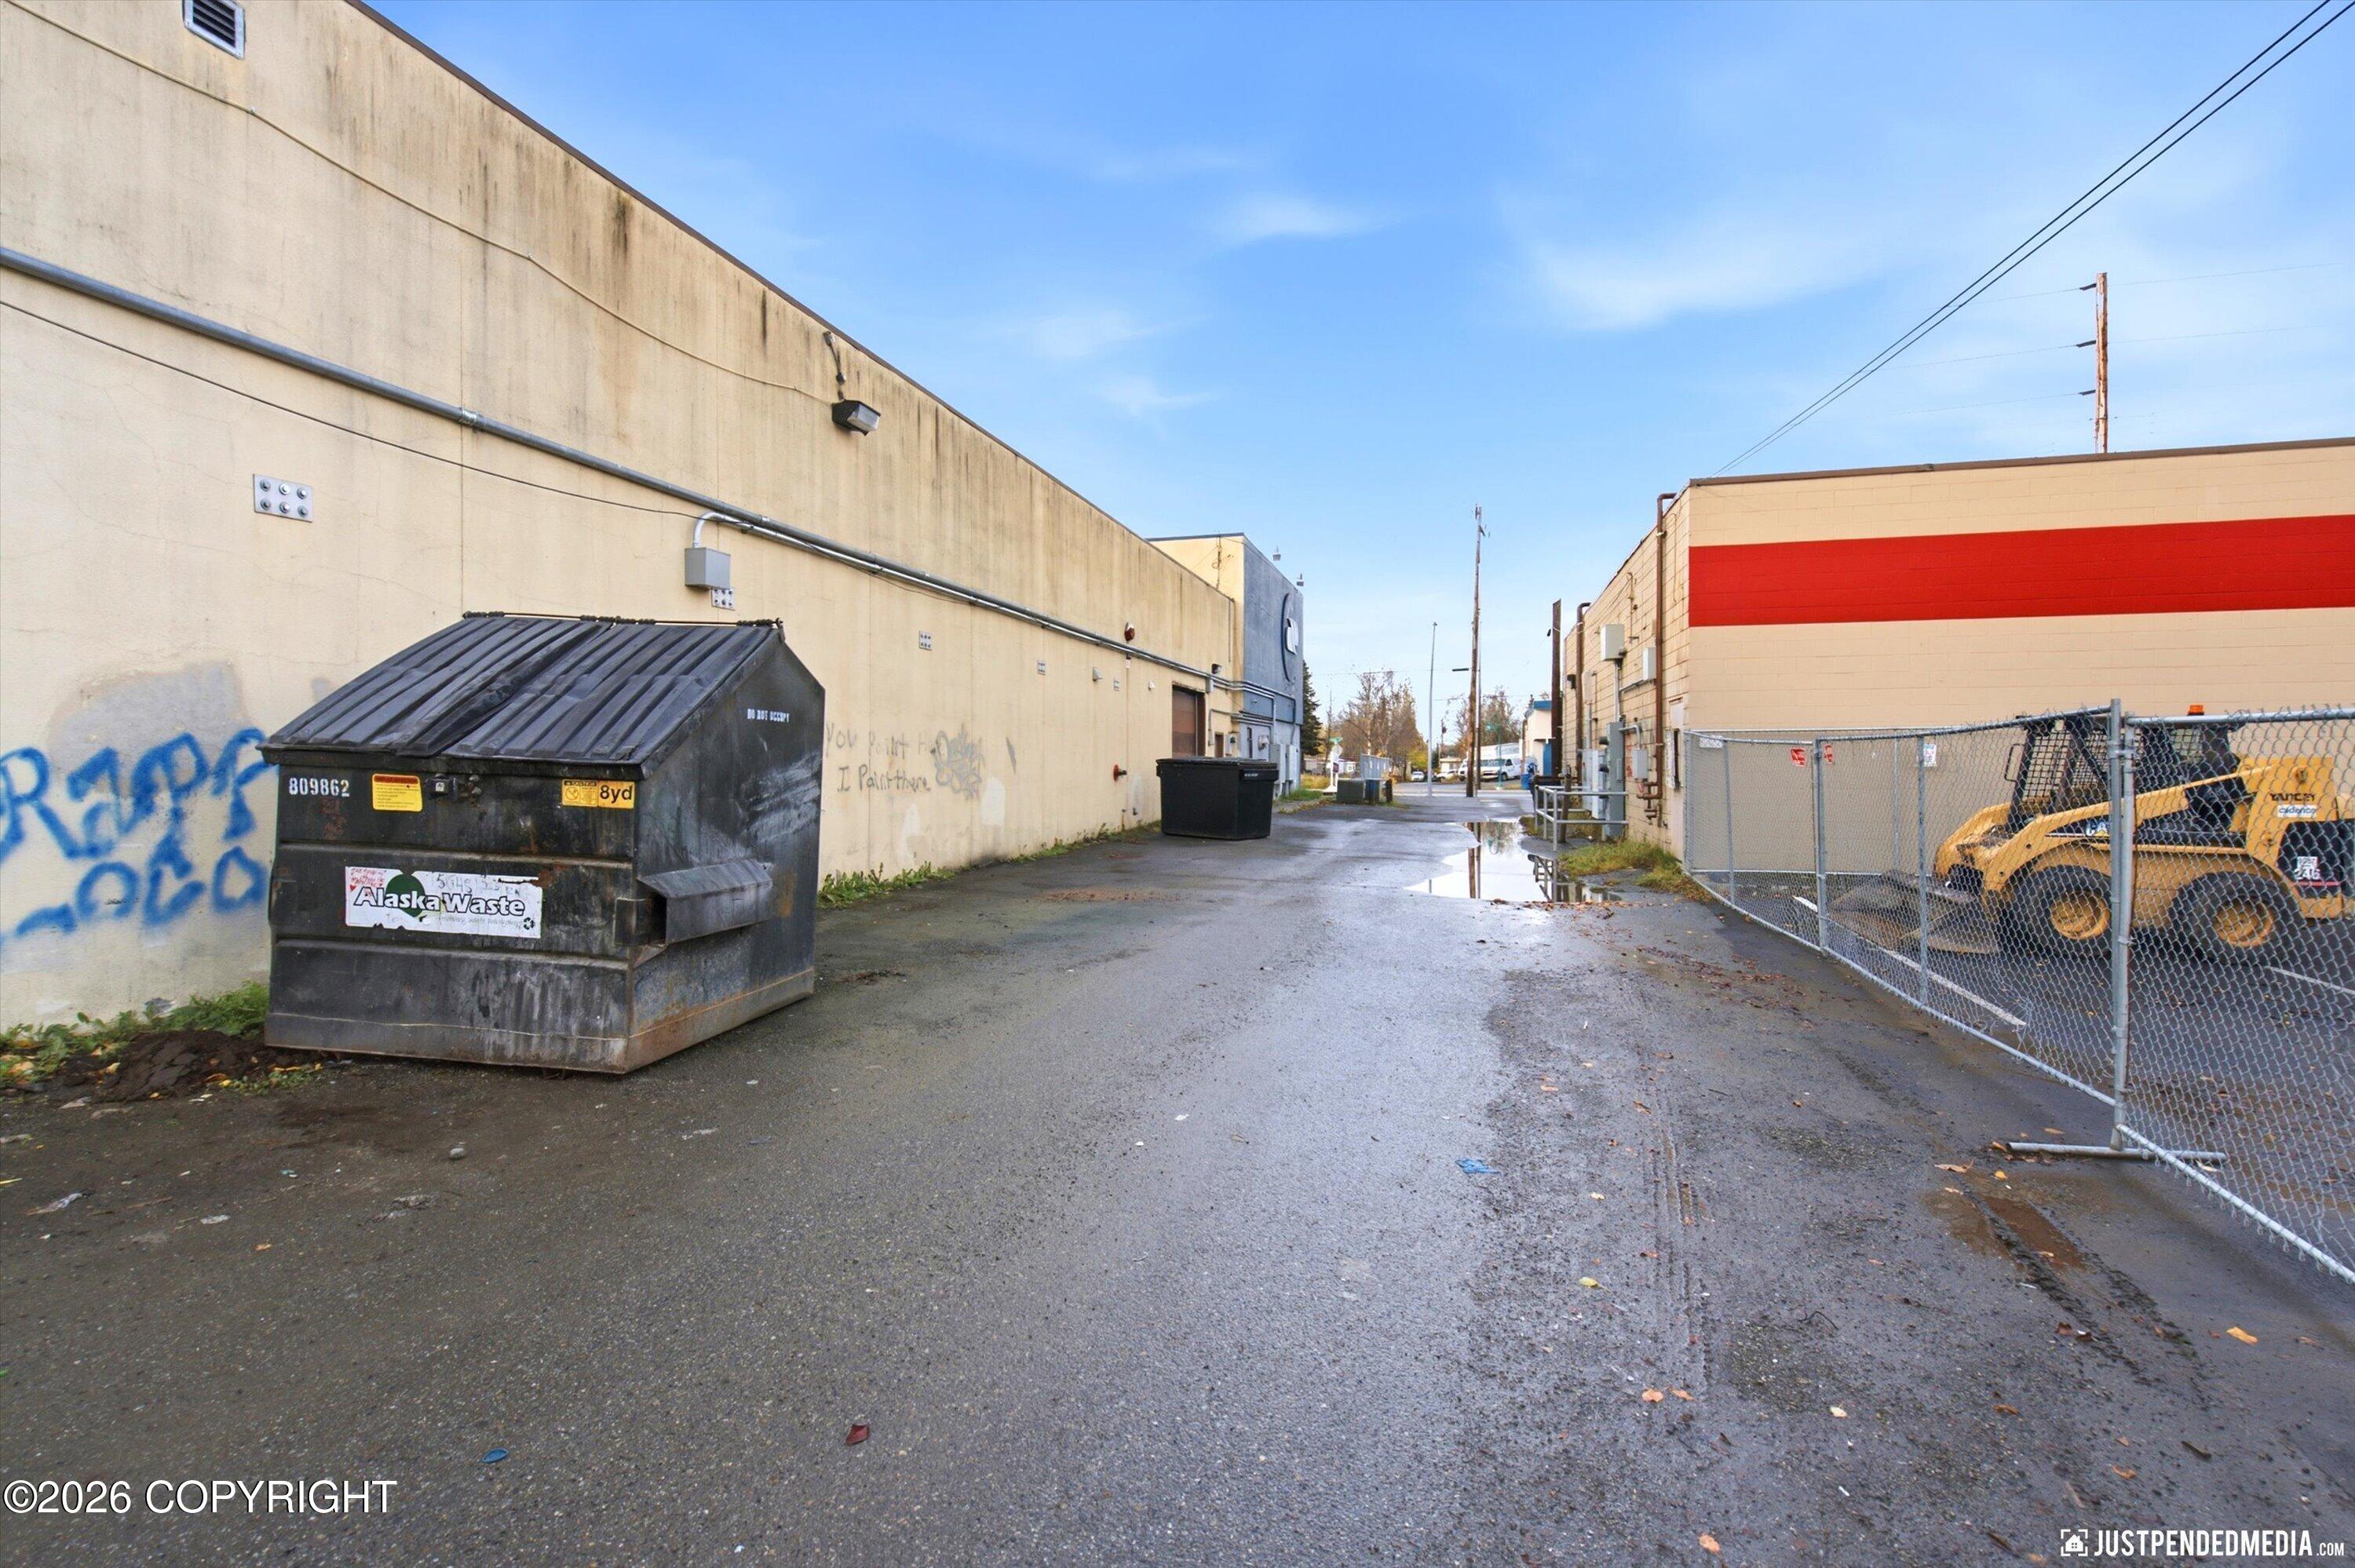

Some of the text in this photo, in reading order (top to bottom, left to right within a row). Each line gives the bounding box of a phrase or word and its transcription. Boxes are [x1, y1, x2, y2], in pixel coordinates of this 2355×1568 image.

[288, 777, 349, 797] 809862
[600, 785, 633, 804] 8yd
[2086, 820, 2110, 837] CA
[353, 885, 525, 916] Alaska Waste
